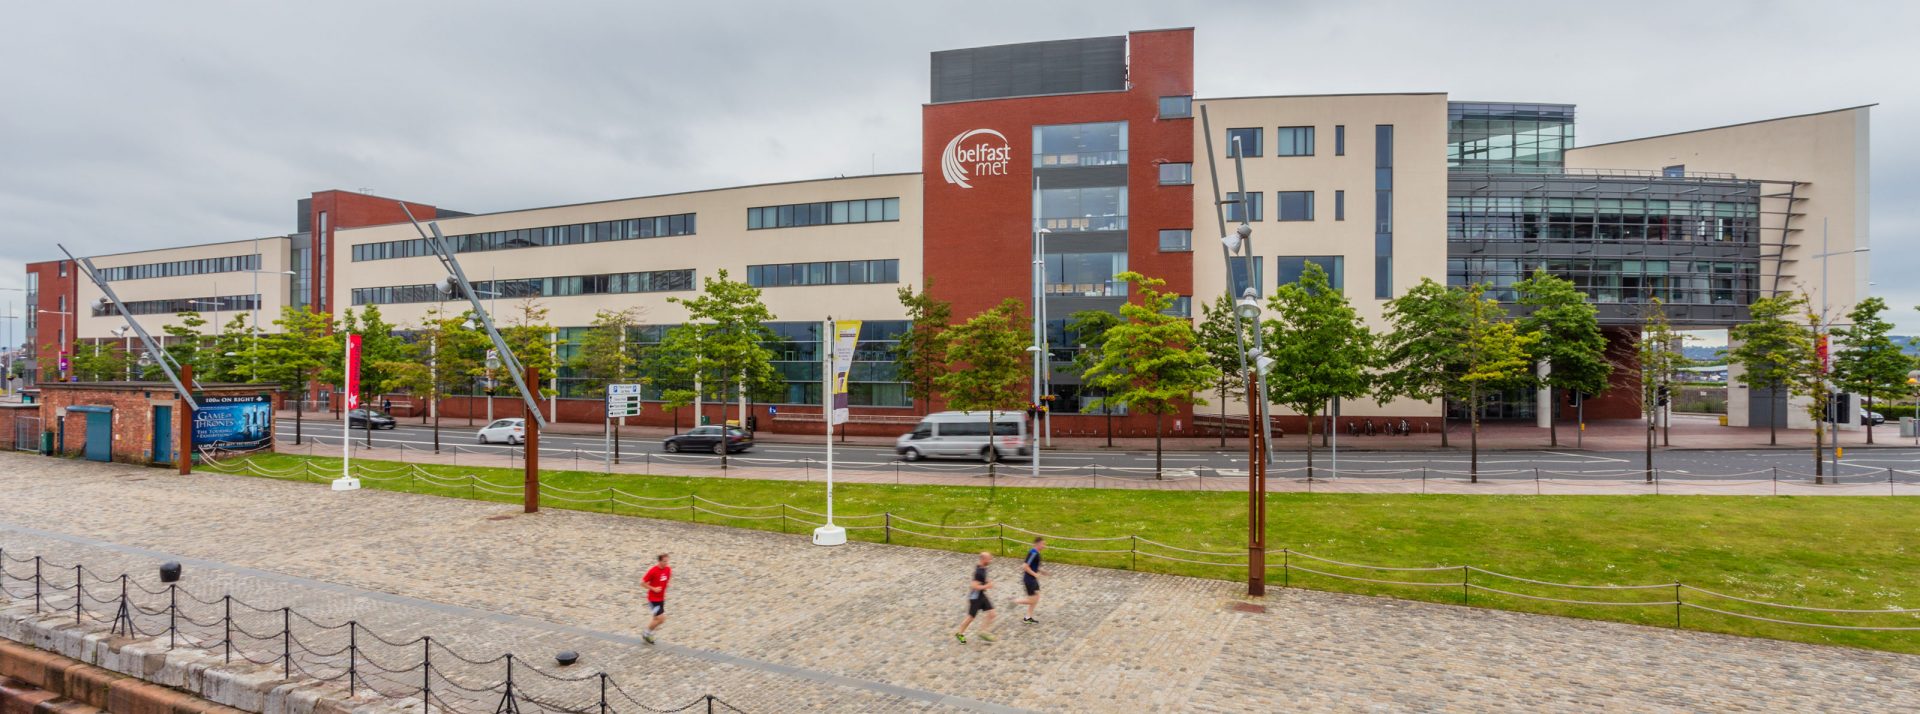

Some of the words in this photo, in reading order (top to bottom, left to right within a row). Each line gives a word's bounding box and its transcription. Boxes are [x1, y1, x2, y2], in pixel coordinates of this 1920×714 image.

[958, 143, 1011, 163] belfast
[976, 158, 1008, 176] met
[198, 412, 225, 420] GAME
[194, 420, 234, 428] THRONES
